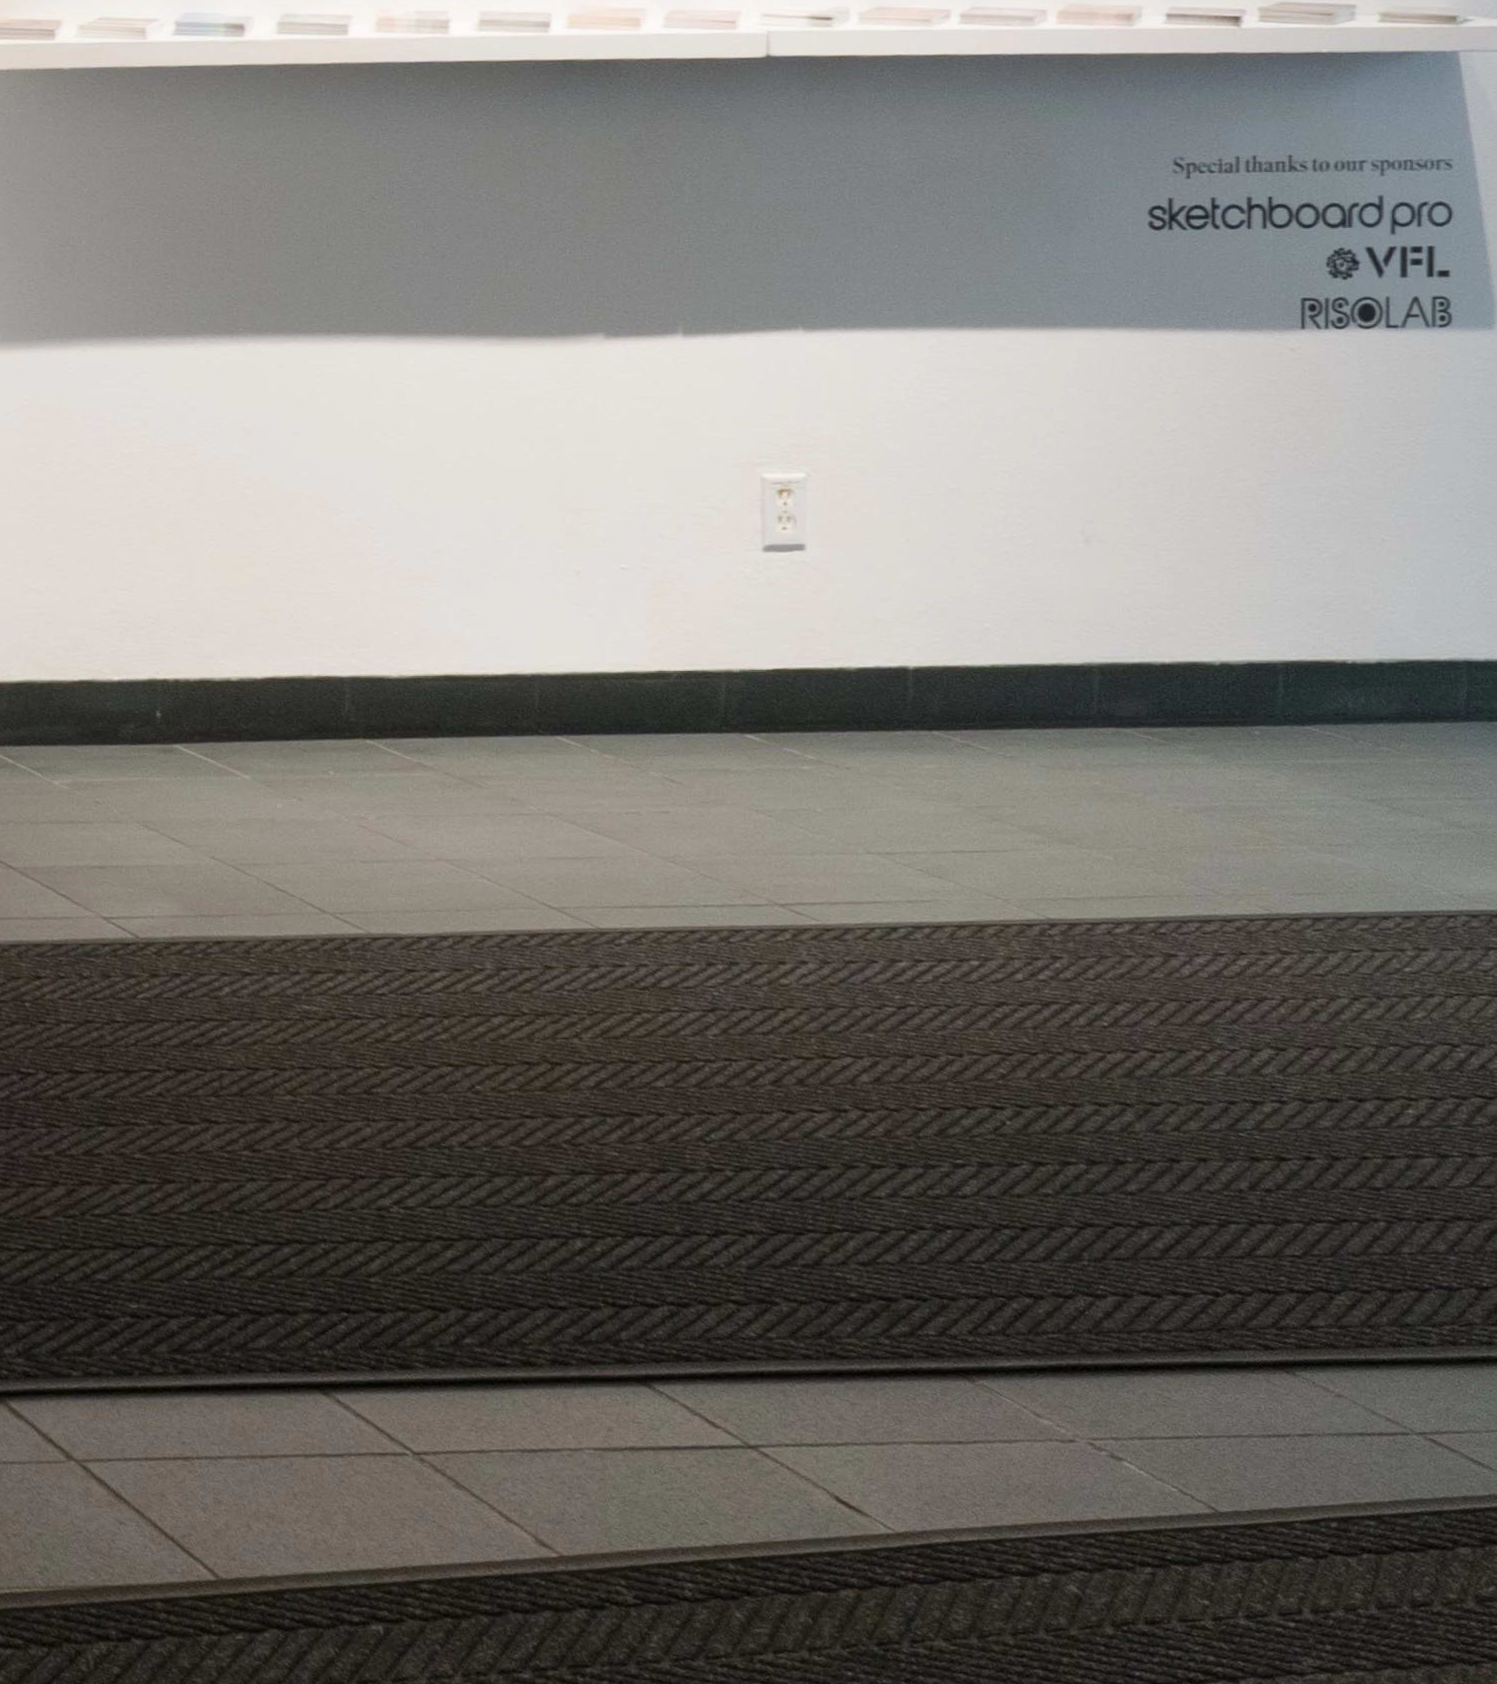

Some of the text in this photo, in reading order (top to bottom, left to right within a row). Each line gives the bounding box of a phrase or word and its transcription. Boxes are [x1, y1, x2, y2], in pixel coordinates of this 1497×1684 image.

[1173, 155, 1453, 179] Special thanks to our sponsors
[1148, 196, 1453, 235] sketchboard pro
[1366, 245, 1452, 279] VFL
